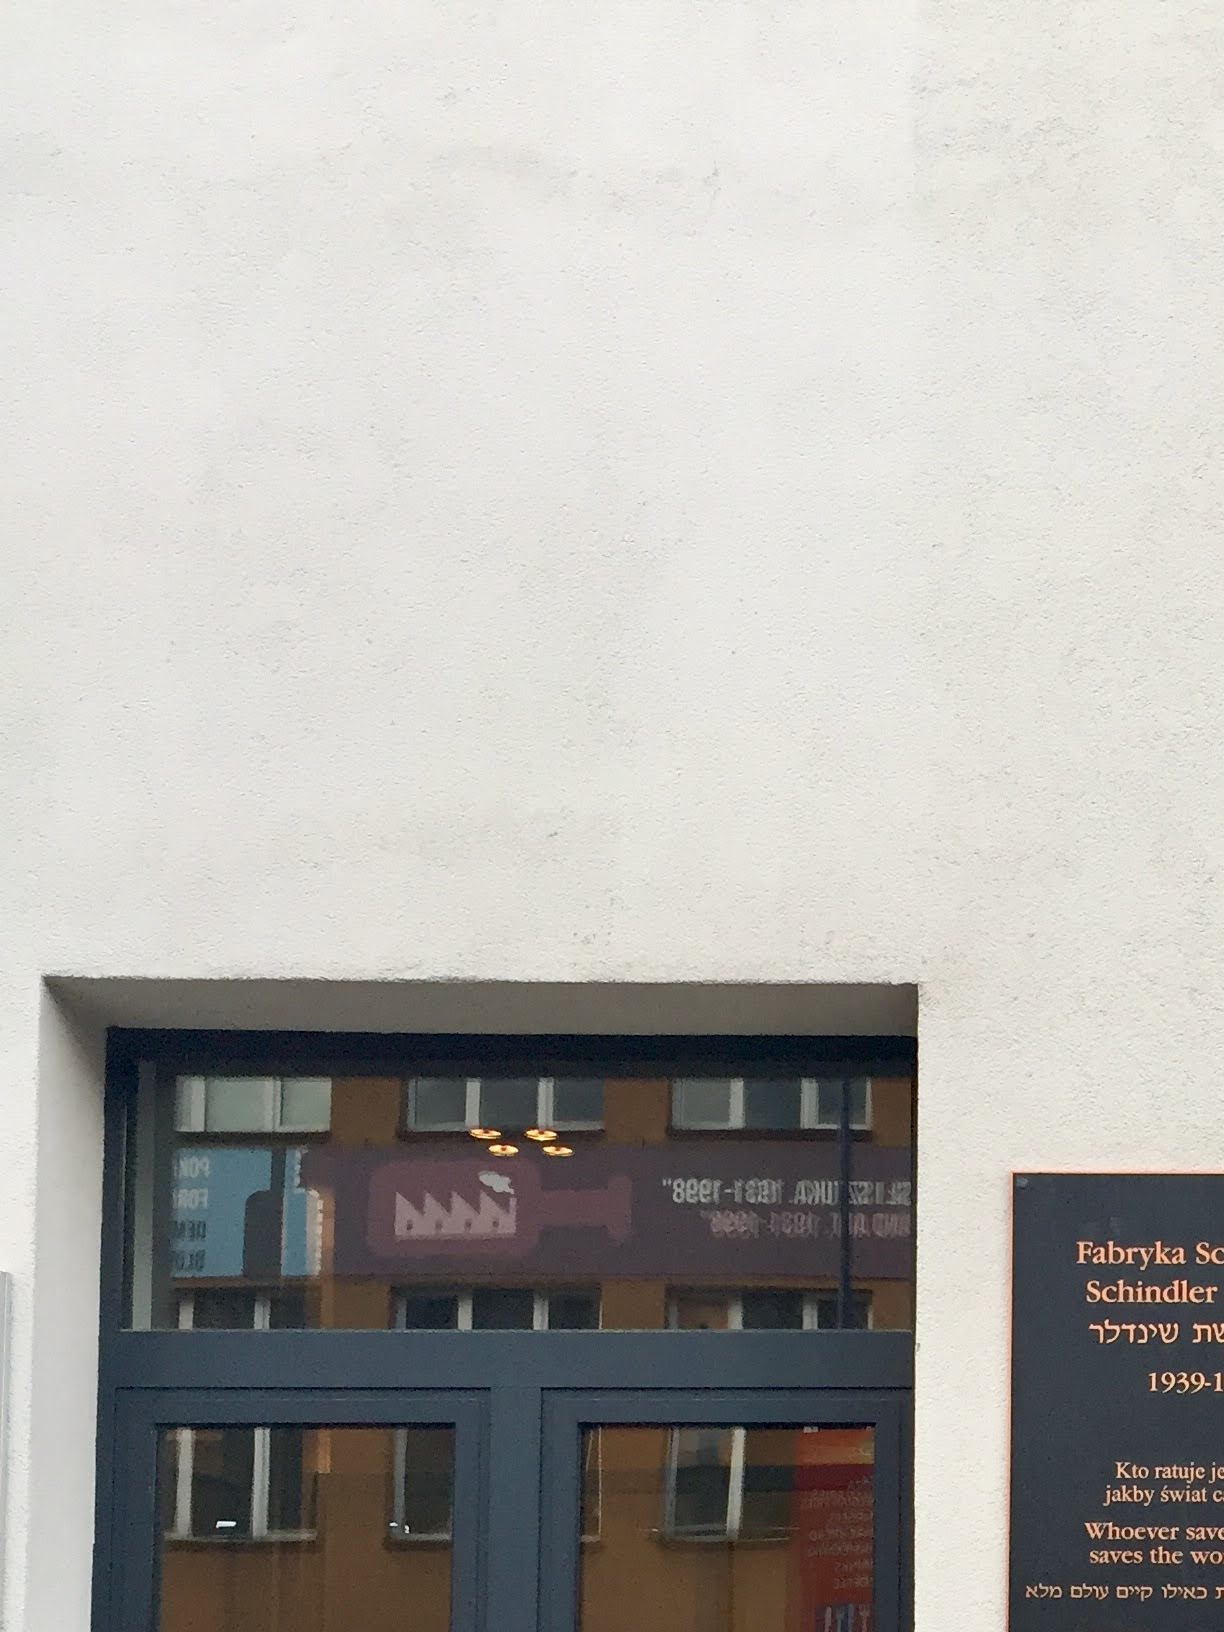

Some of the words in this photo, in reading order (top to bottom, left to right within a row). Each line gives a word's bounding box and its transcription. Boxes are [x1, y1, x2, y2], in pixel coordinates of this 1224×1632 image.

[1077, 1241, 1186, 1270] Fabryka
[1086, 1280, 1218, 1303] Schindler
[1089, 1319, 1178, 1343] שינדלר
[1116, 1462, 1149, 1479] Kto
[1155, 1462, 1205, 1484] ratuje
[1103, 1485, 1154, 1506] jakby
[1161, 1485, 1207, 1502] świat
[1084, 1522, 1179, 1541] Whoever
[1090, 1550, 1143, 1563] saves
[1150, 1546, 1183, 1564] the
[1026, 1583, 1062, 1598] מלא
[1070, 1583, 1109, 1600] עולם
[1116, 1586, 1153, 1601] קיים
[1161, 1584, 1207, 1599] כאילו
